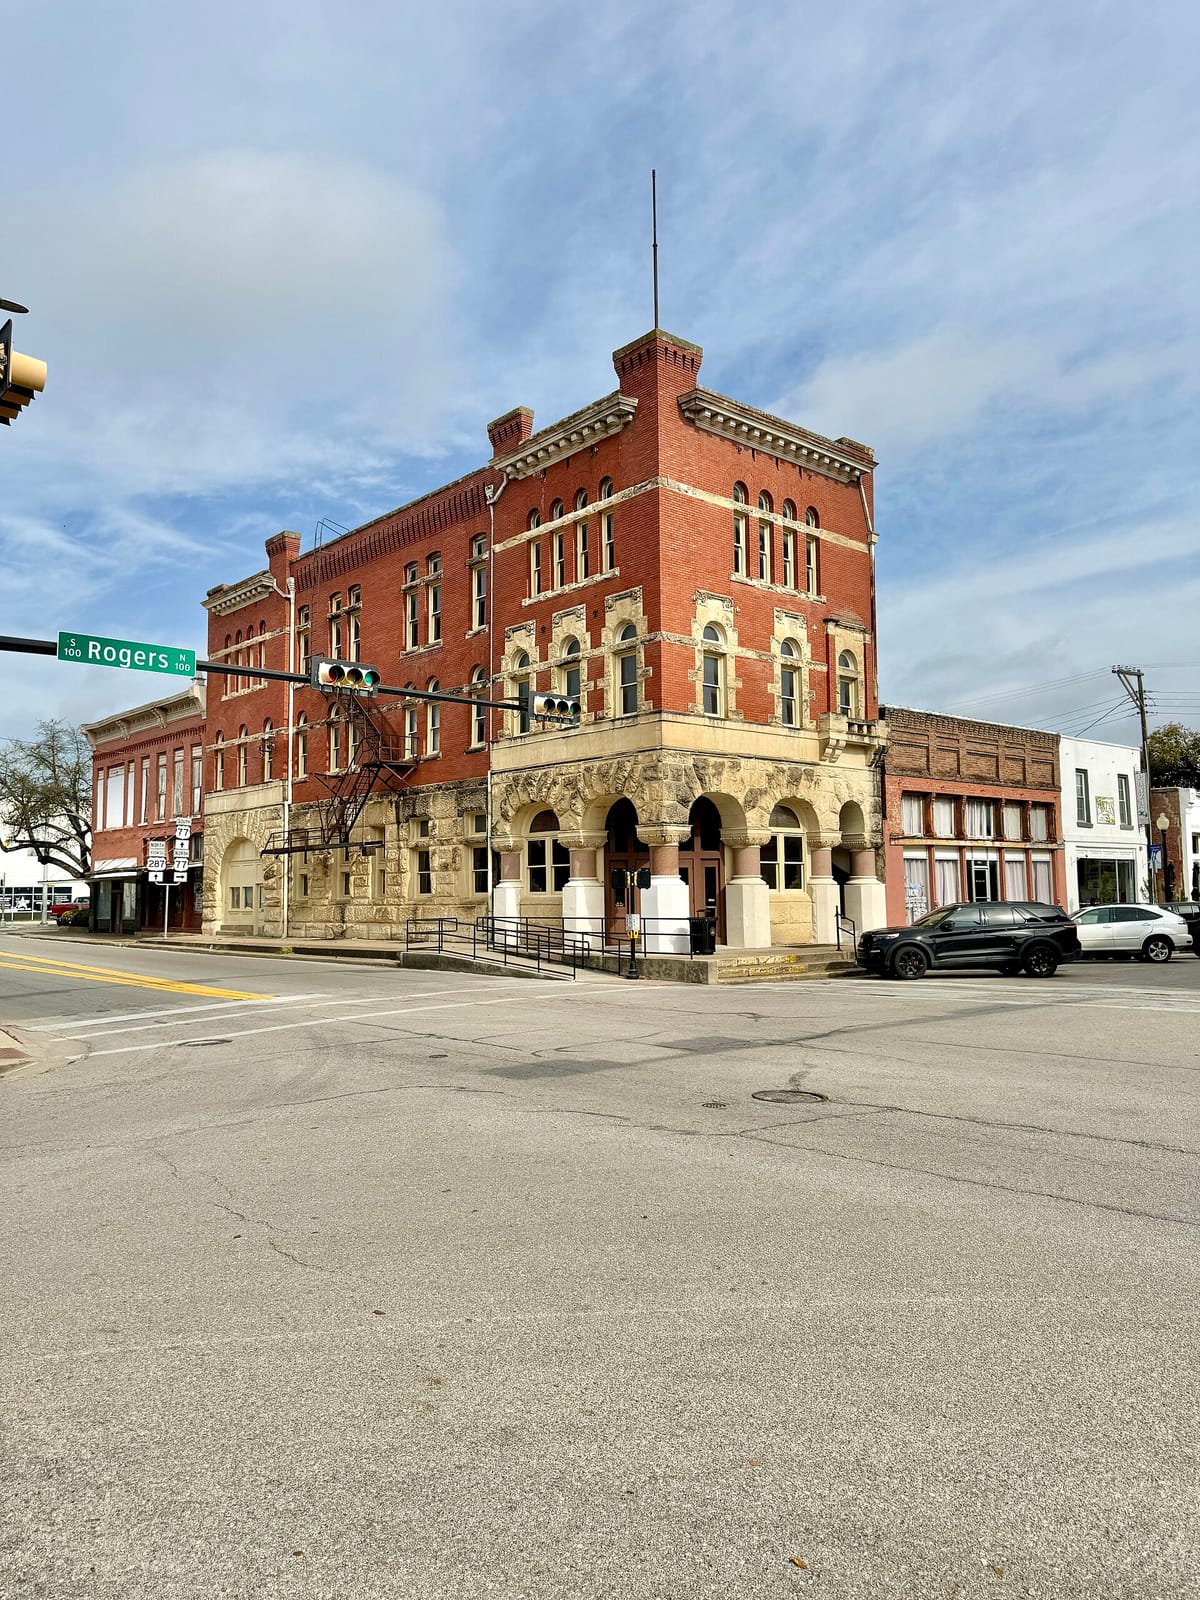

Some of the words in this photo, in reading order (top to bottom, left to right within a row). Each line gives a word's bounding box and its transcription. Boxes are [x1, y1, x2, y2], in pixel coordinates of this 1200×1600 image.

[69, 638, 76, 647] S
[64, 648, 81, 658] 100
[88, 641, 169, 668] Rogers
[179, 654, 186, 662] N
[175, 662, 190, 672] 100
[177, 828, 189, 837] 77
[148, 860, 165, 868] 287
[175, 860, 187, 869] 77
